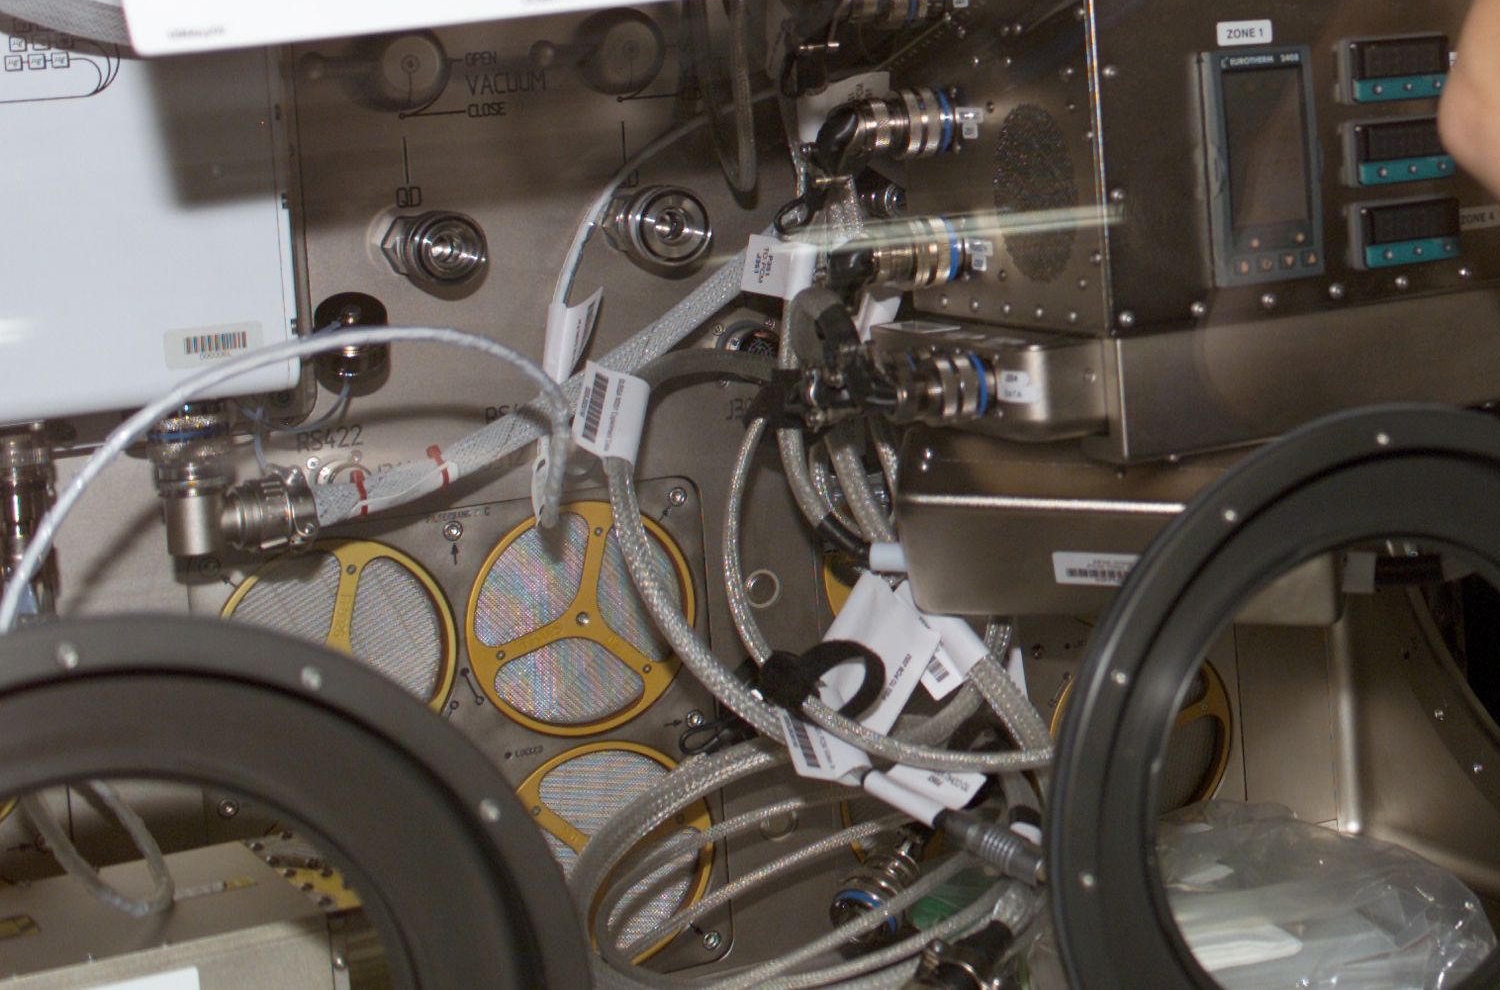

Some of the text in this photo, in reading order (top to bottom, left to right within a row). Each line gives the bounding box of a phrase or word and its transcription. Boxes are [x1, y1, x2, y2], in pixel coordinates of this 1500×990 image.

[1227, 28, 1263, 40] ZONE 1
[465, 51, 497, 67] OPEN
[465, 70, 547, 97] VACUUM
[467, 102, 506, 119] CLOSE
[395, 186, 422, 209] QD
[1460, 211, 1495, 225] ZONE 4
[763, 247, 770, 260] TO
[297, 425, 363, 453] RS422
